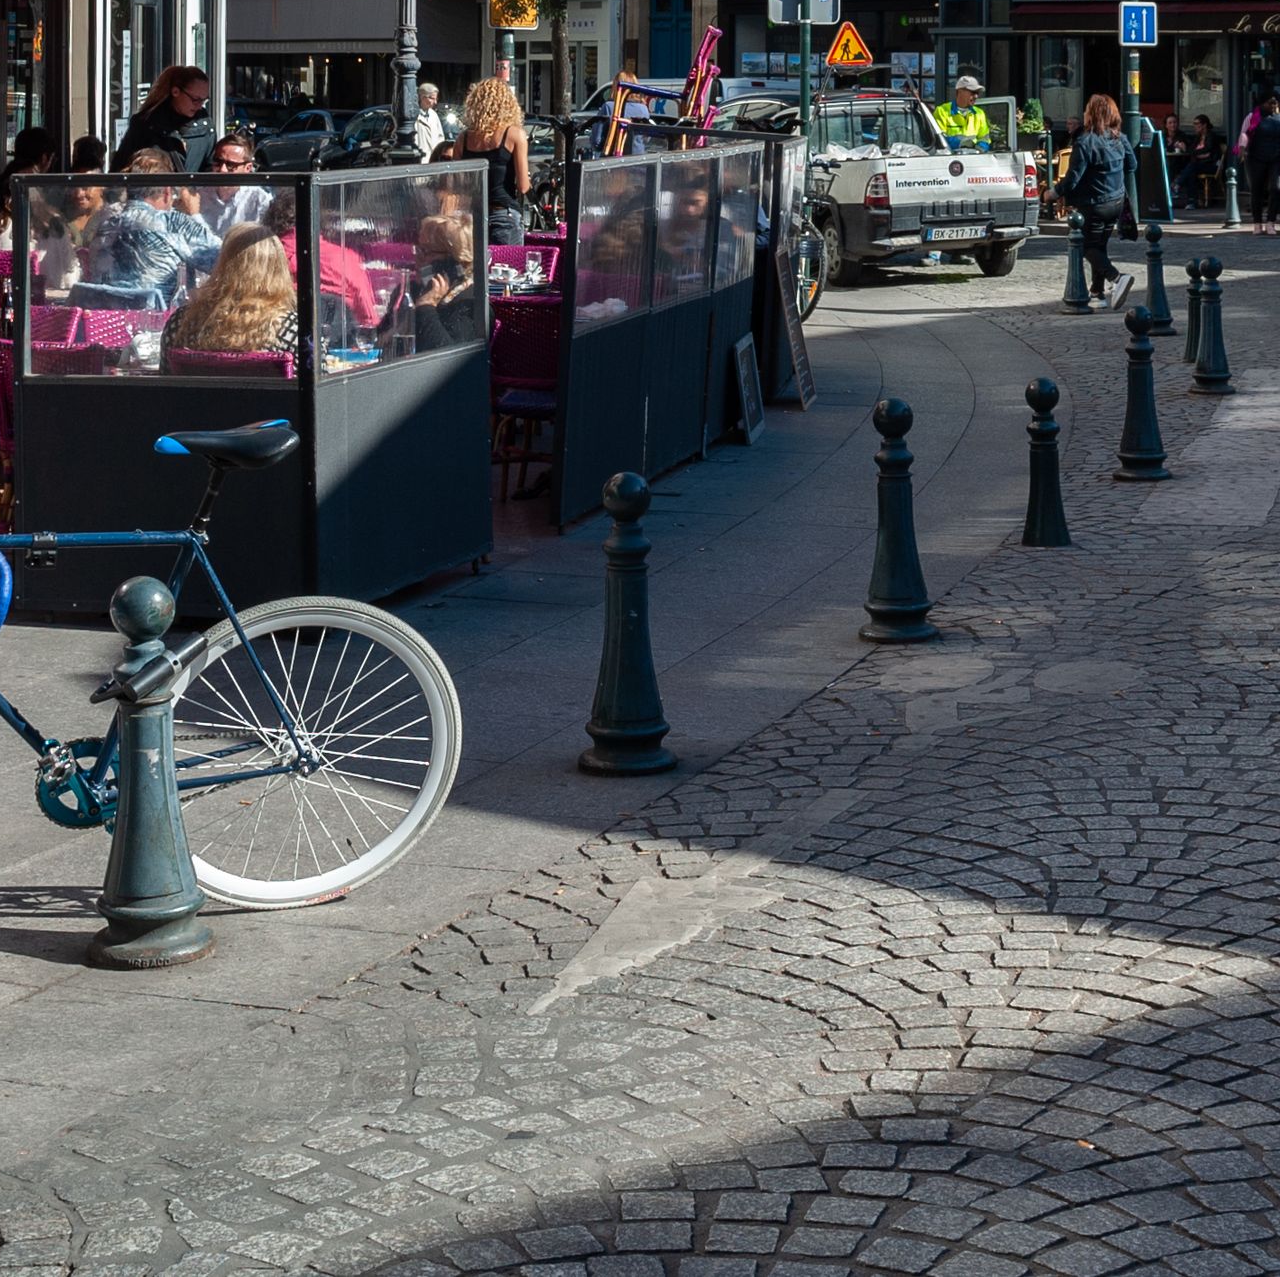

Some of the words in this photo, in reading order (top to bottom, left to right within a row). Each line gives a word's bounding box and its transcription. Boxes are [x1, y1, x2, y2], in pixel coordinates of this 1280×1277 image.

[1227, 14, 1252, 34] Le
[895, 177, 950, 189] Intervention
[967, 176, 988, 185] ARRETS
